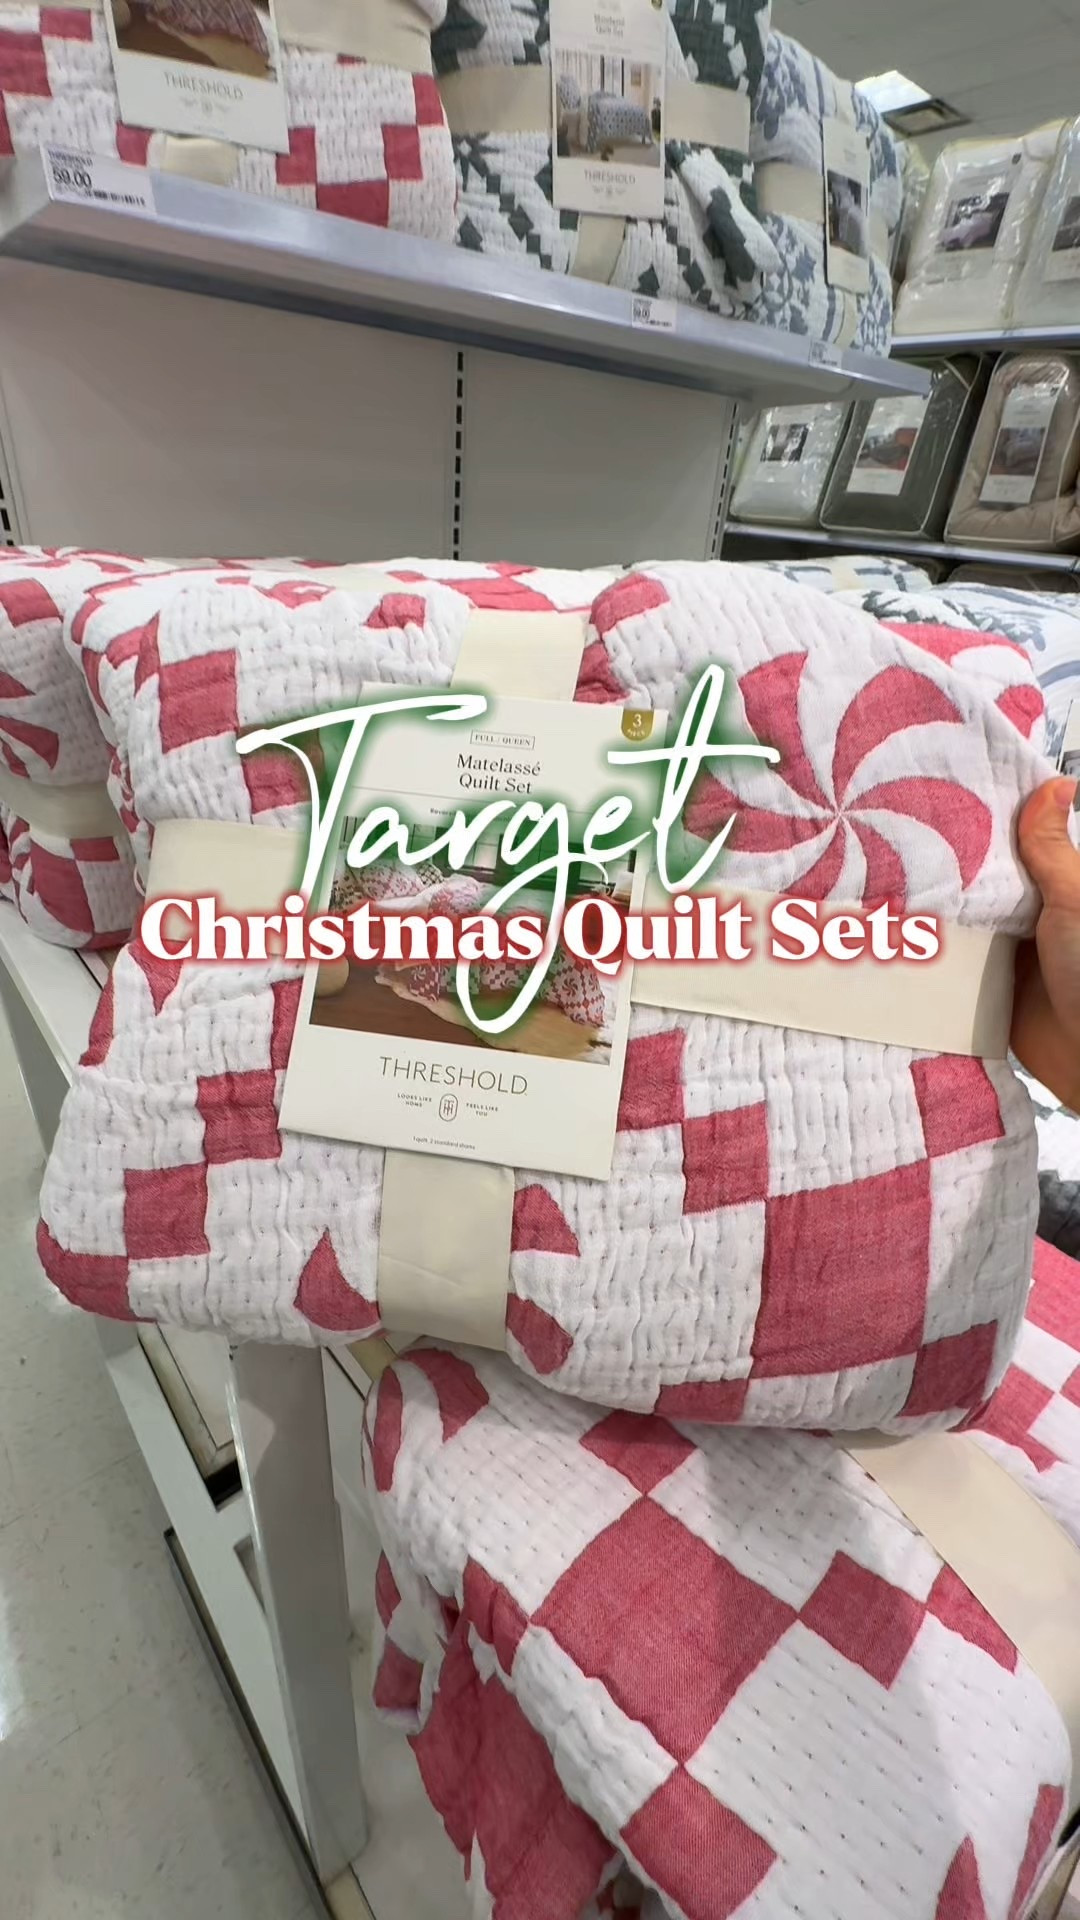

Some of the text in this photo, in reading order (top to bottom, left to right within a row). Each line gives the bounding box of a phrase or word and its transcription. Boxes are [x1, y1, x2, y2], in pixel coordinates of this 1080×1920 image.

[164, 71, 244, 99] THRESHOLD
[584, 168, 636, 185] THRESHOLD
[632, 713, 642, 728] 3
[474, 733, 495, 744] FULL
[502, 736, 531, 747] QUEEN
[457, 754, 541, 776] Matelassé
[459, 773, 532, 794] Quilt Set
[380, 1056, 528, 1095] THRESHOLD
[397, 1092, 418, 1101] LOOKS
[406, 1100, 423, 1108] HOME
